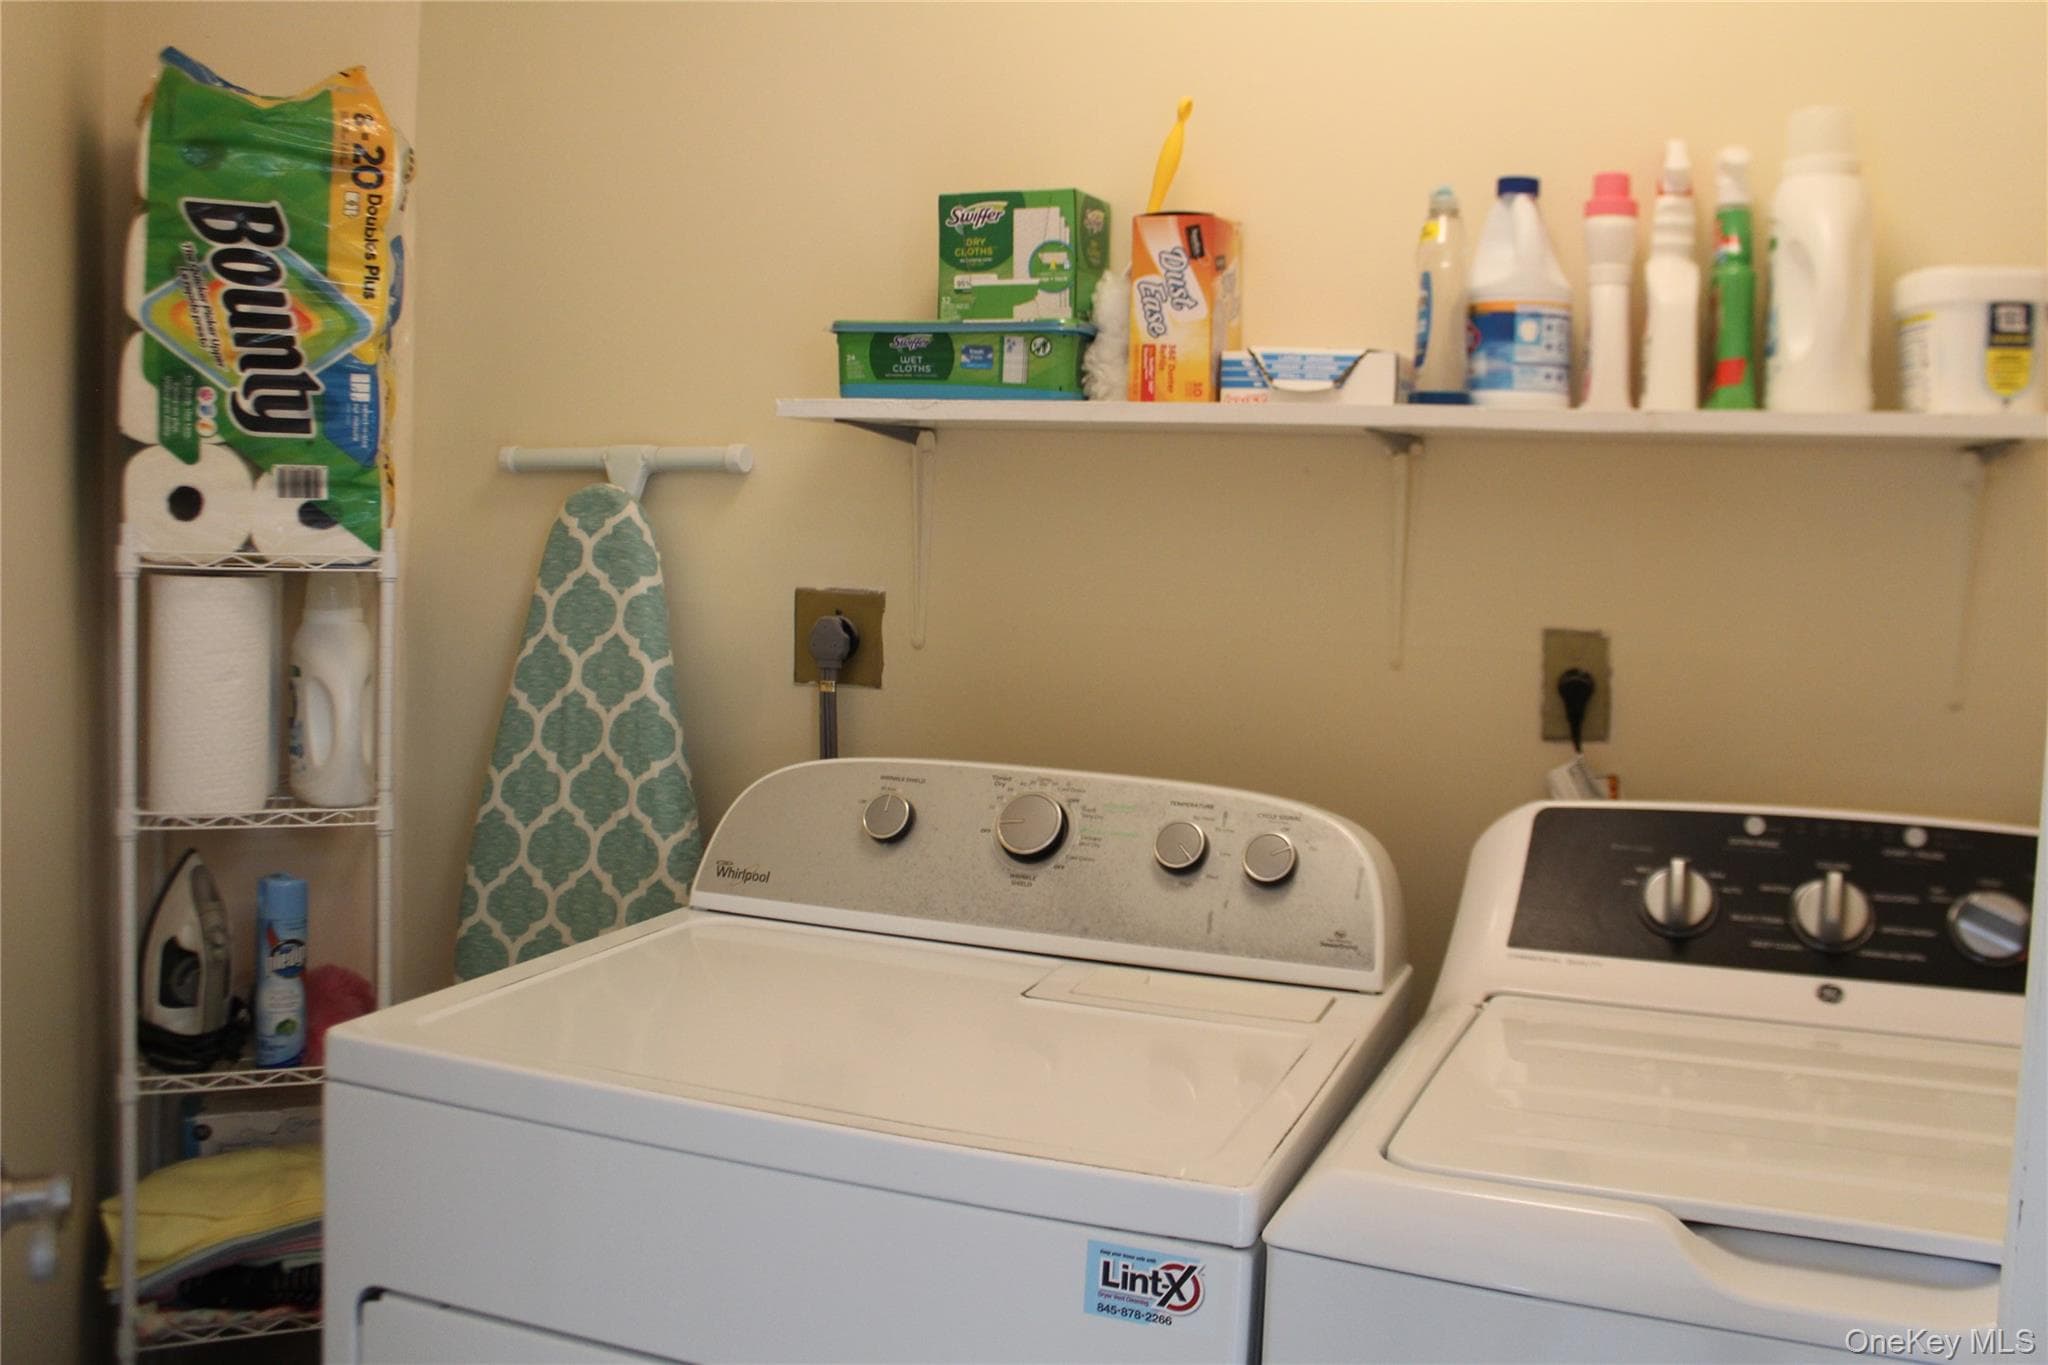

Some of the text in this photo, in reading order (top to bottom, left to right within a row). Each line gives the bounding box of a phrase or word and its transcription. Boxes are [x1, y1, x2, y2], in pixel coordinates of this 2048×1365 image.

[352, 144, 386, 190] 20
[947, 205, 1005, 229] Swiffer
[954, 247, 993, 257] CLOTHS
[966, 237, 987, 246] DRY
[361, 264, 380, 300] Plus
[1158, 246, 1199, 312] Dust
[183, 200, 322, 436] Bounty
[1136, 280, 1168, 339] Ease
[890, 334, 931, 350] Swiffer
[892, 365, 931, 373] CLOTHS
[900, 355, 923, 363] WET
[716, 864, 771, 884] Whirlpool
[1101, 1260, 1199, 1308] Lint-X
